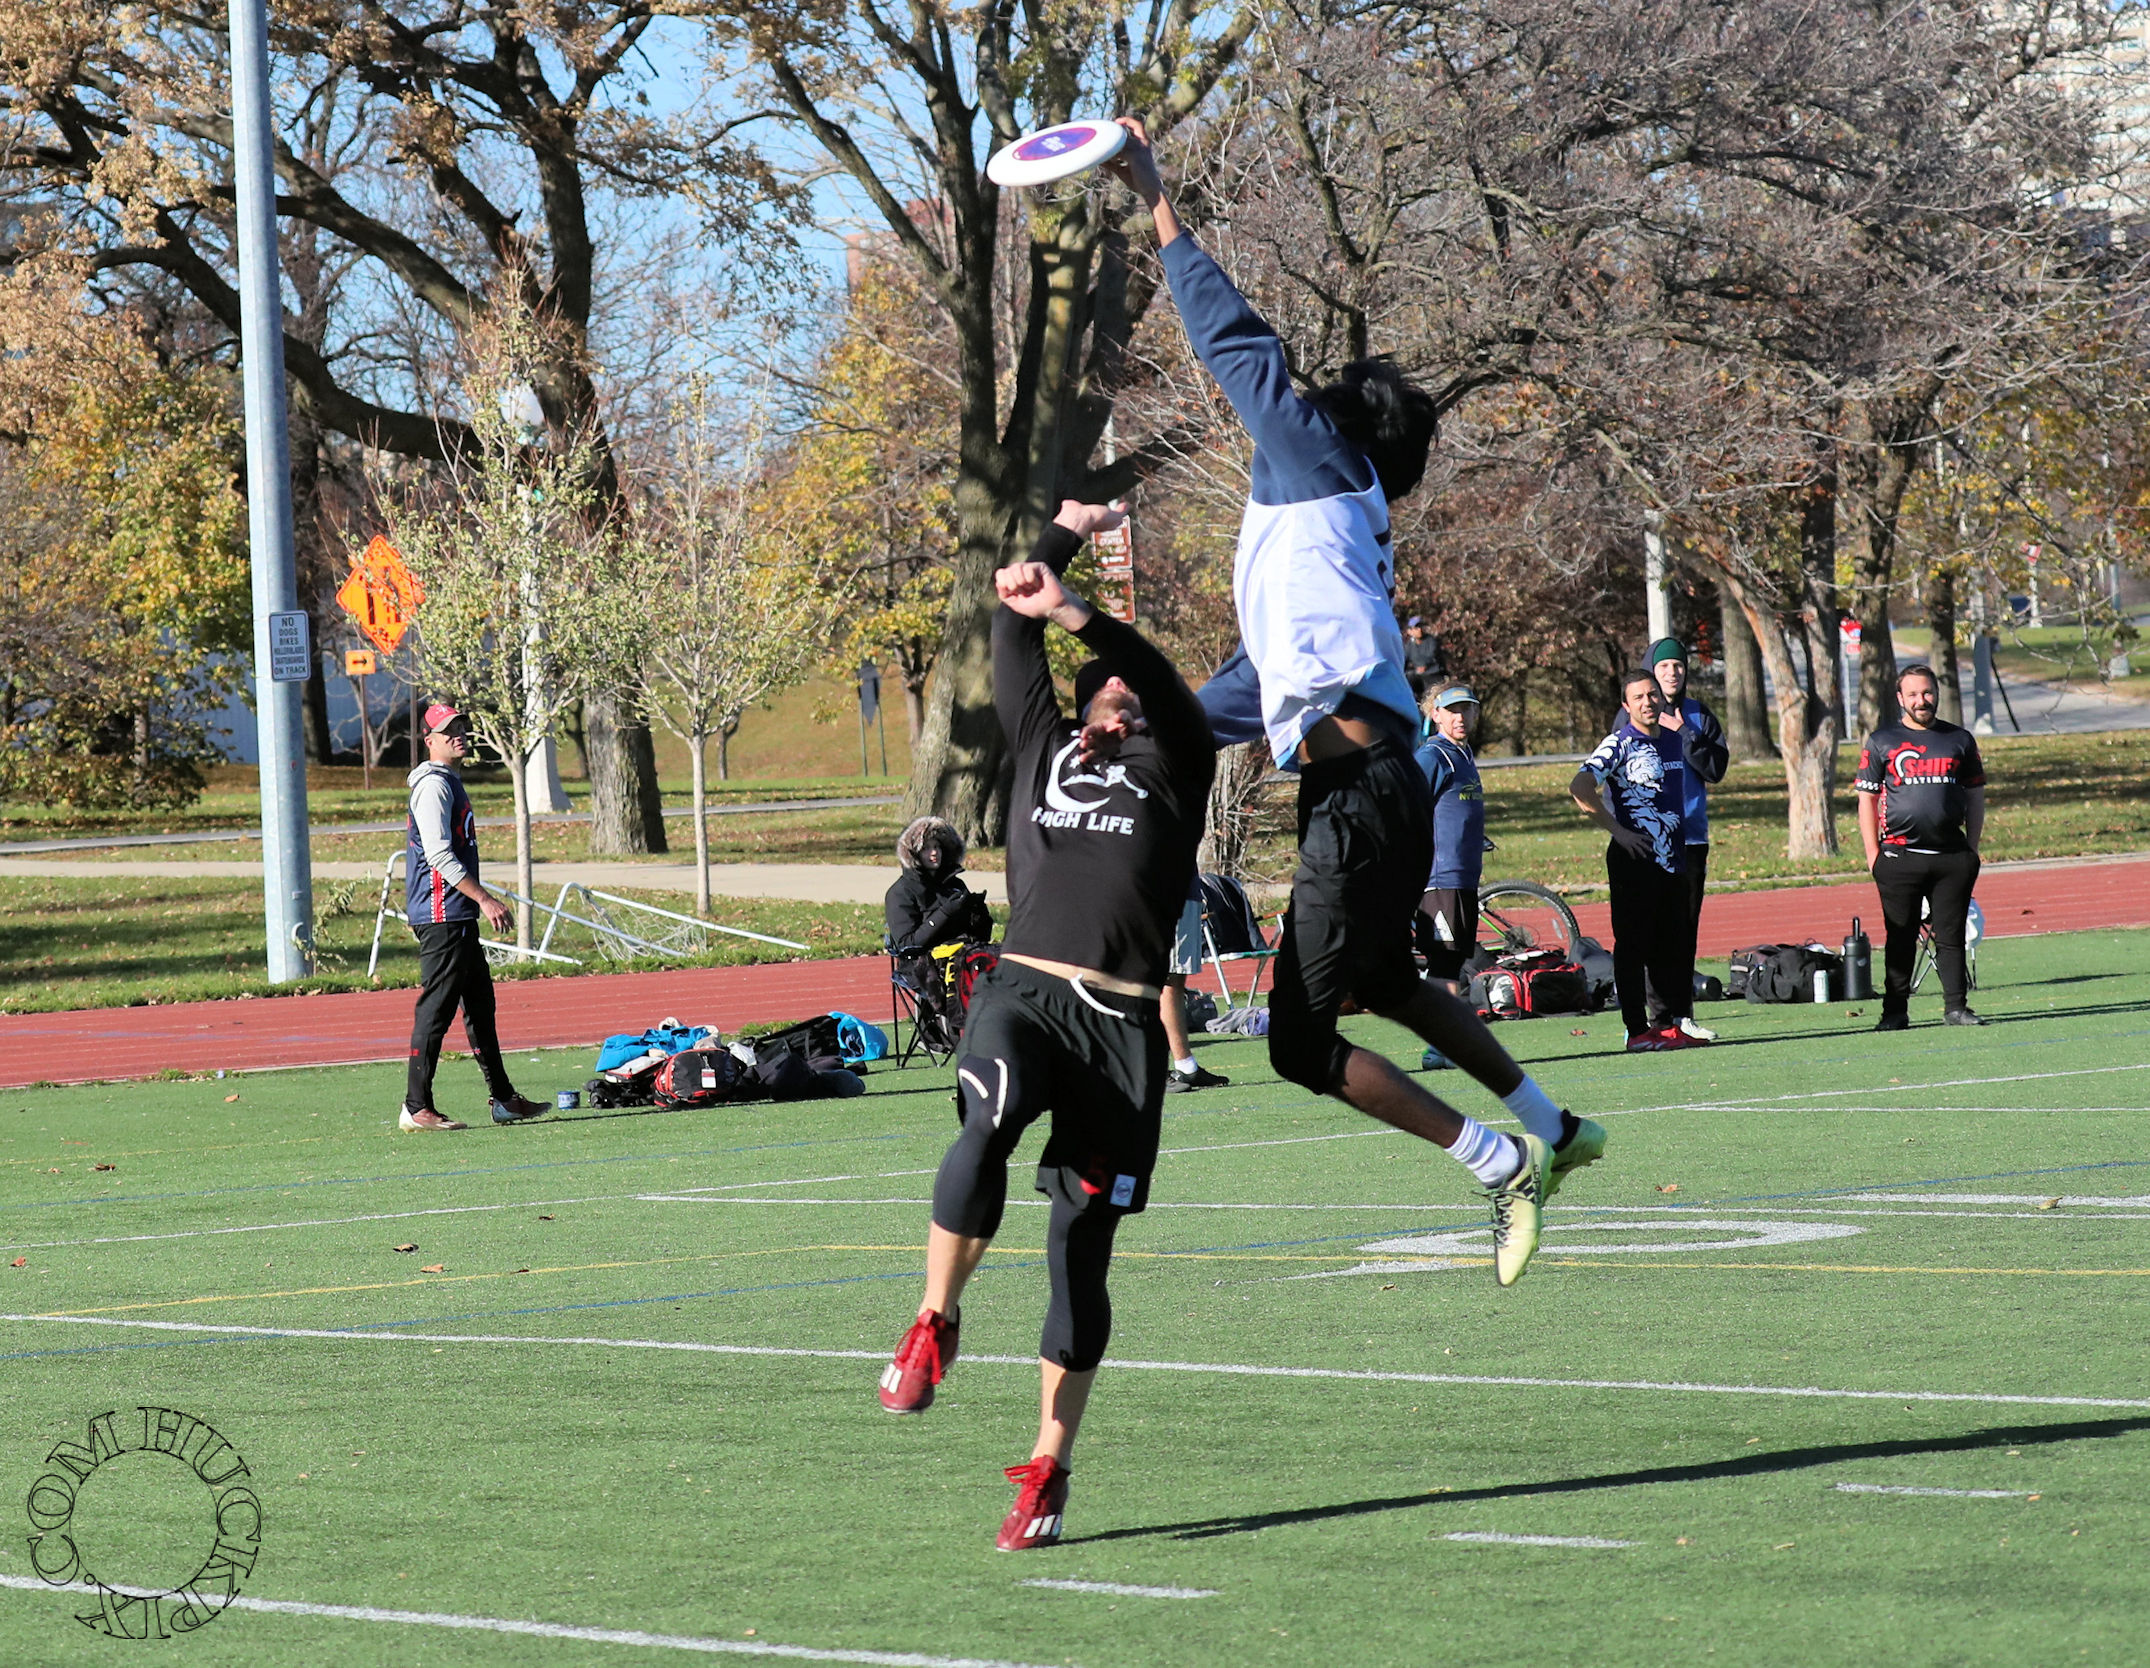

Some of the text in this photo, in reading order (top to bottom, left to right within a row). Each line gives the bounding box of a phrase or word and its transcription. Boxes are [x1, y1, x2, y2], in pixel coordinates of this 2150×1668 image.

[281, 617, 294, 627] NO
[279, 628, 298, 636] DOGS
[279, 637, 299, 646] BIKES
[274, 665, 307, 675] ON TRACK
[1031, 806, 1135, 835] HIGH LIFE
